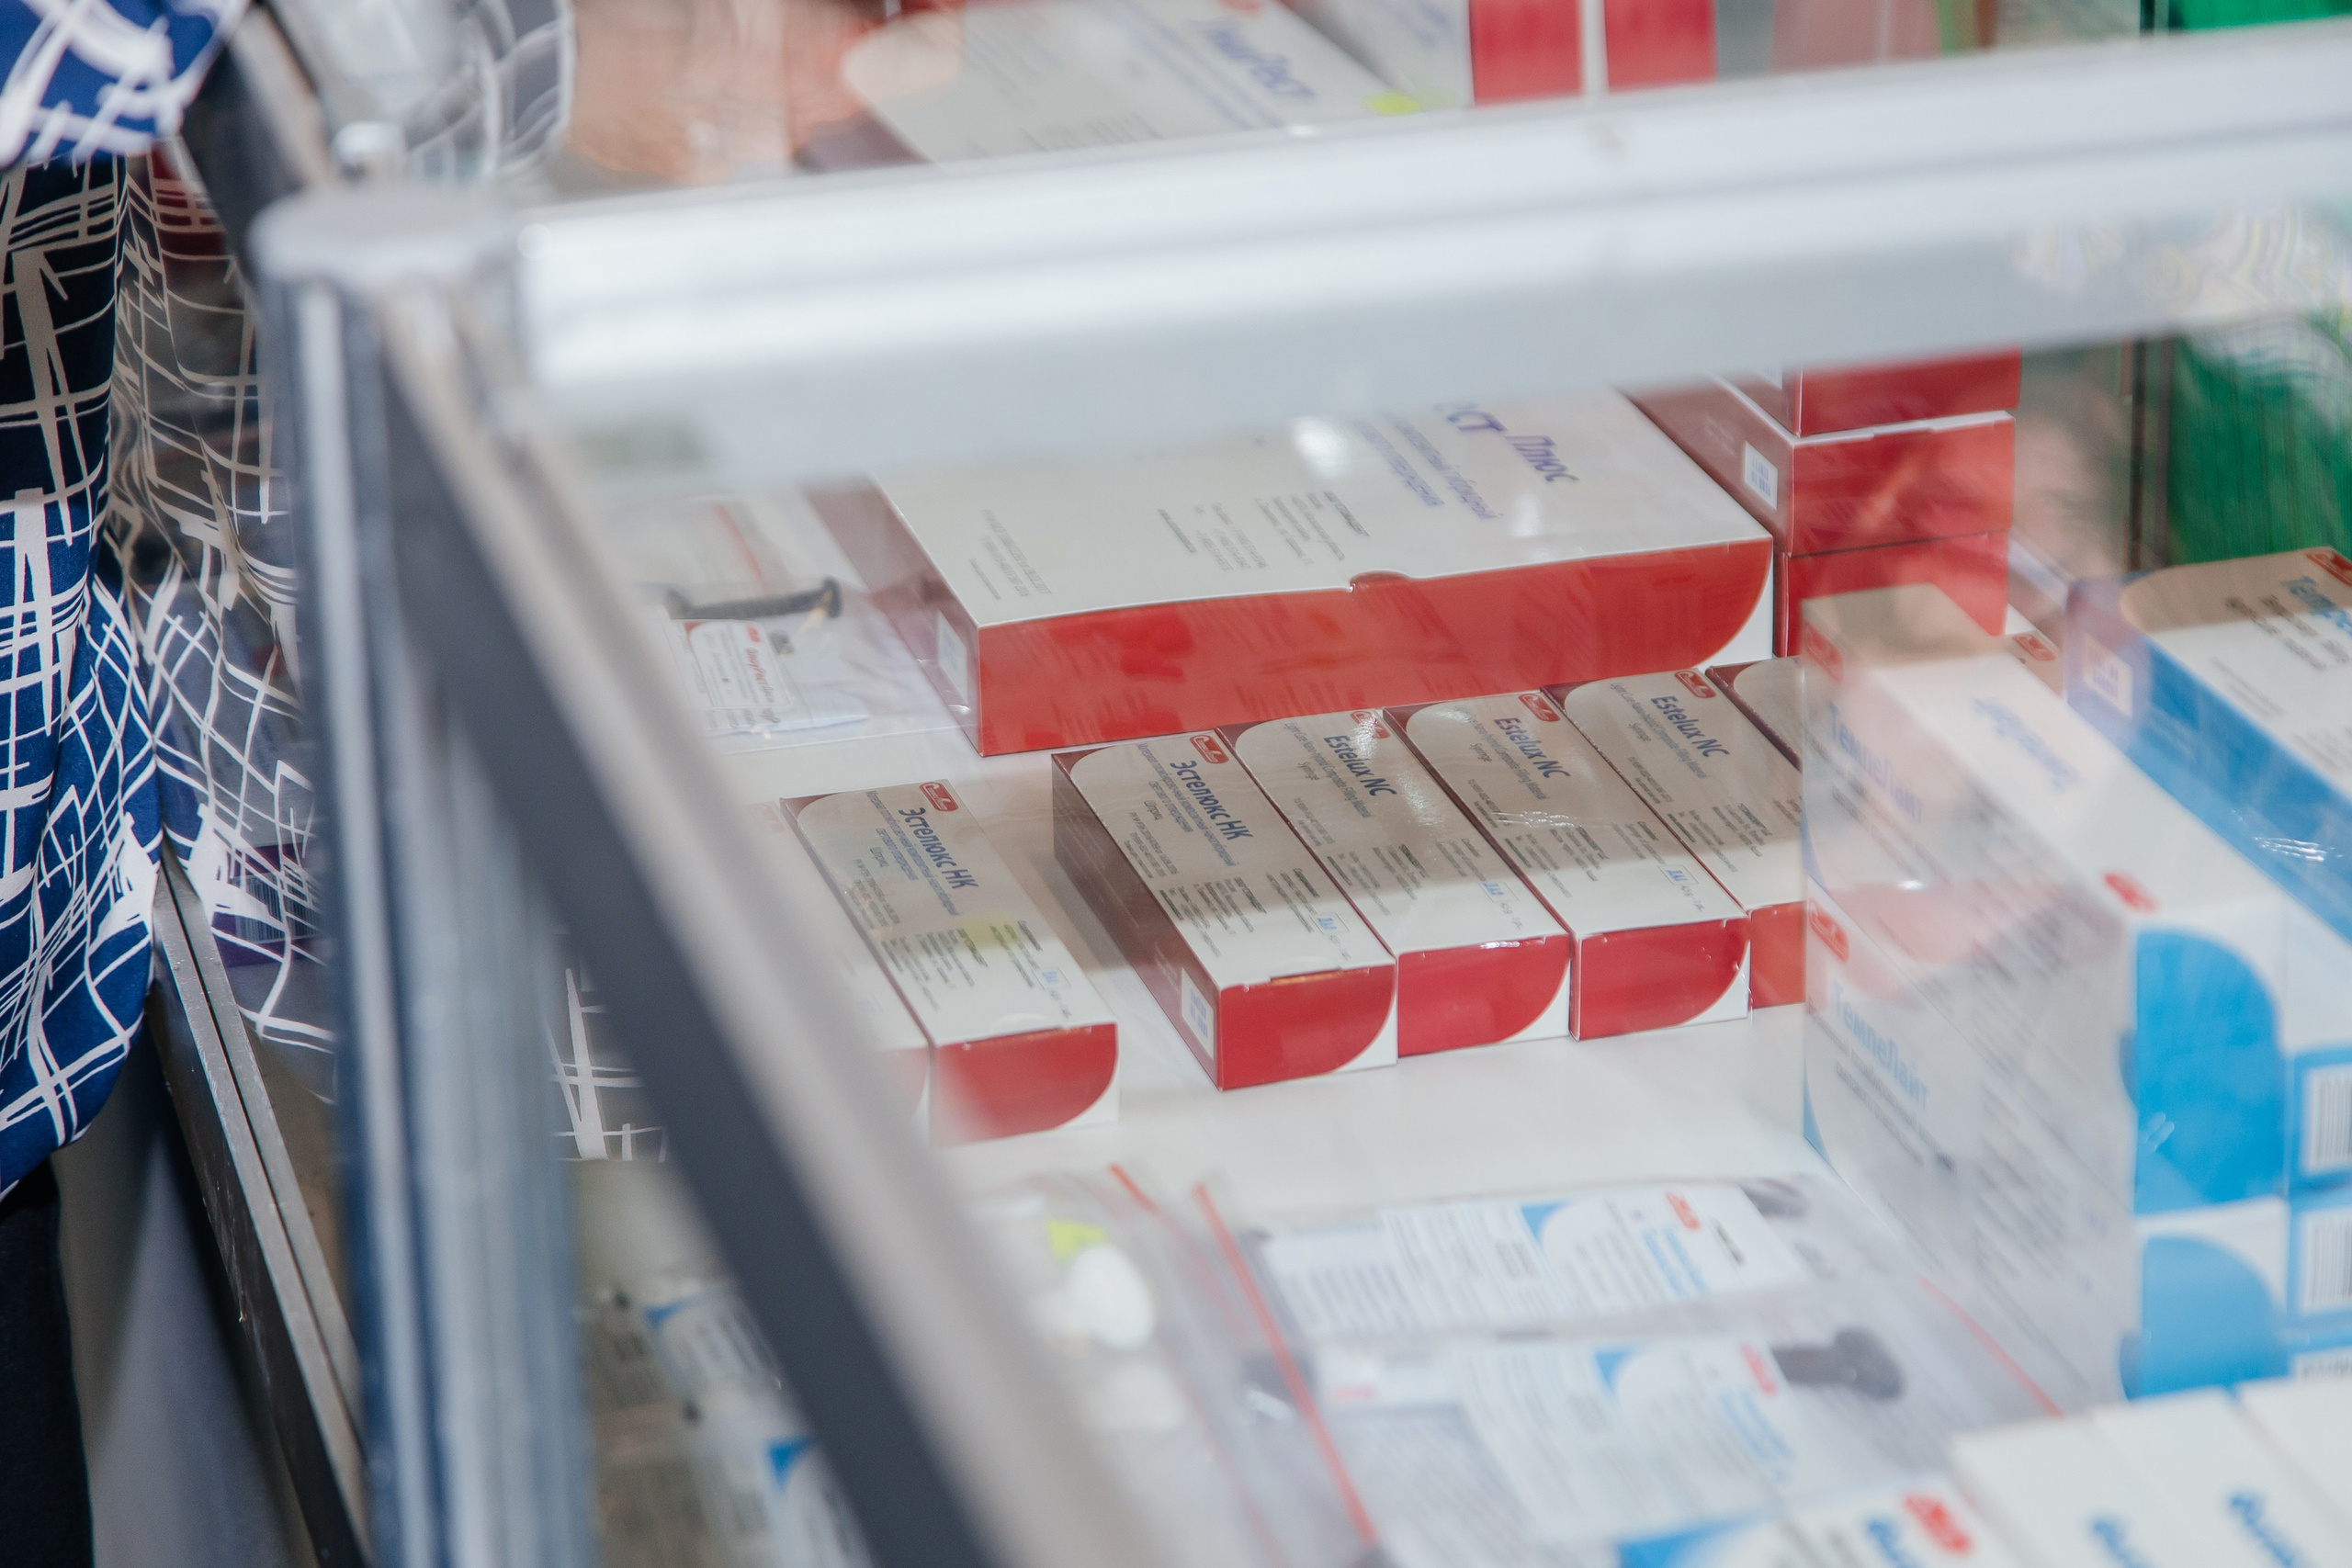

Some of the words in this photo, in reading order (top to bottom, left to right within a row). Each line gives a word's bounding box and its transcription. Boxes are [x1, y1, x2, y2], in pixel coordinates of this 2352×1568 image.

[1469, 742, 1492, 761] Syringe
[1495, 717, 1544, 759] Estelux
[1532, 761, 1569, 777] NC
[1652, 696, 1702, 738] Estelux
[1692, 739, 1728, 757] NC
[1297, 761, 1319, 780] Syringe
[1324, 735, 1371, 776] Estelux
[1360, 778, 1396, 795] NC
[1143, 800, 1162, 820] Шприц
[1170, 761, 1228, 818] Эстелюкс
[1216, 820, 1251, 840] НК
[869, 846, 888, 867] Шприц
[899, 807, 955, 866] Эстелюкс
[942, 869, 978, 888] НК
